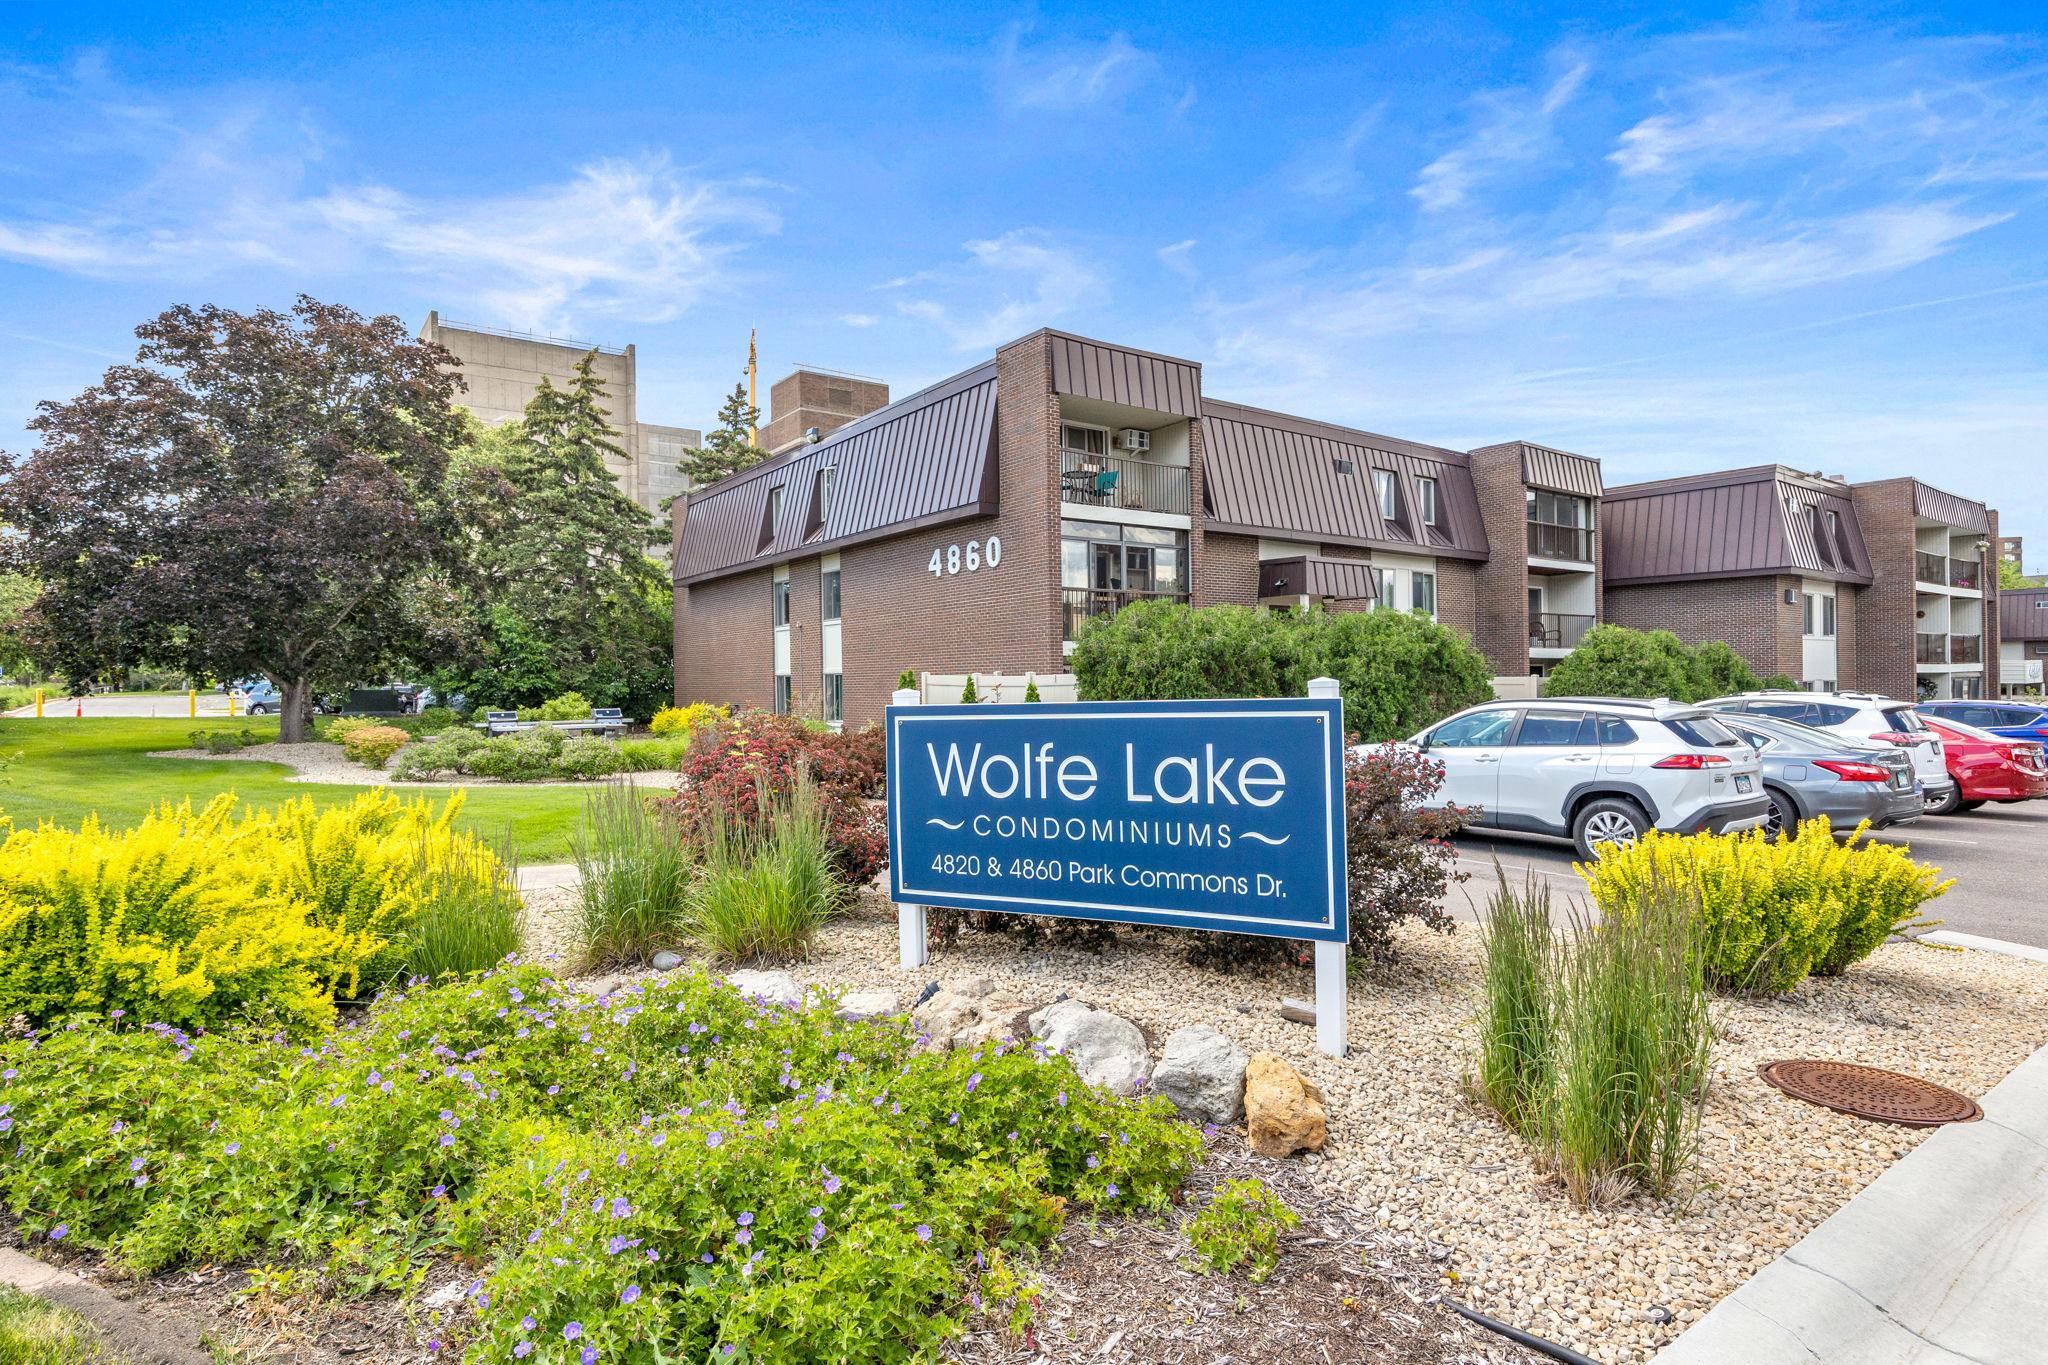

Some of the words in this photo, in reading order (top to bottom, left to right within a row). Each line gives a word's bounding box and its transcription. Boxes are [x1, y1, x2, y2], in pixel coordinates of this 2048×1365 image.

[928, 536, 1001, 577] 4860
[926, 742, 1098, 801] Wolfe
[1126, 742, 1286, 808] Lake
[973, 814, 1232, 849] CONDOMINIUMS
[931, 854, 981, 876] 4820
[987, 856, 1003, 877] &
[1009, 858, 1062, 881] 4860
[1069, 861, 1115, 885] Park
[1120, 864, 1249, 895] Commons
[1256, 873, 1287, 898] Dr.
